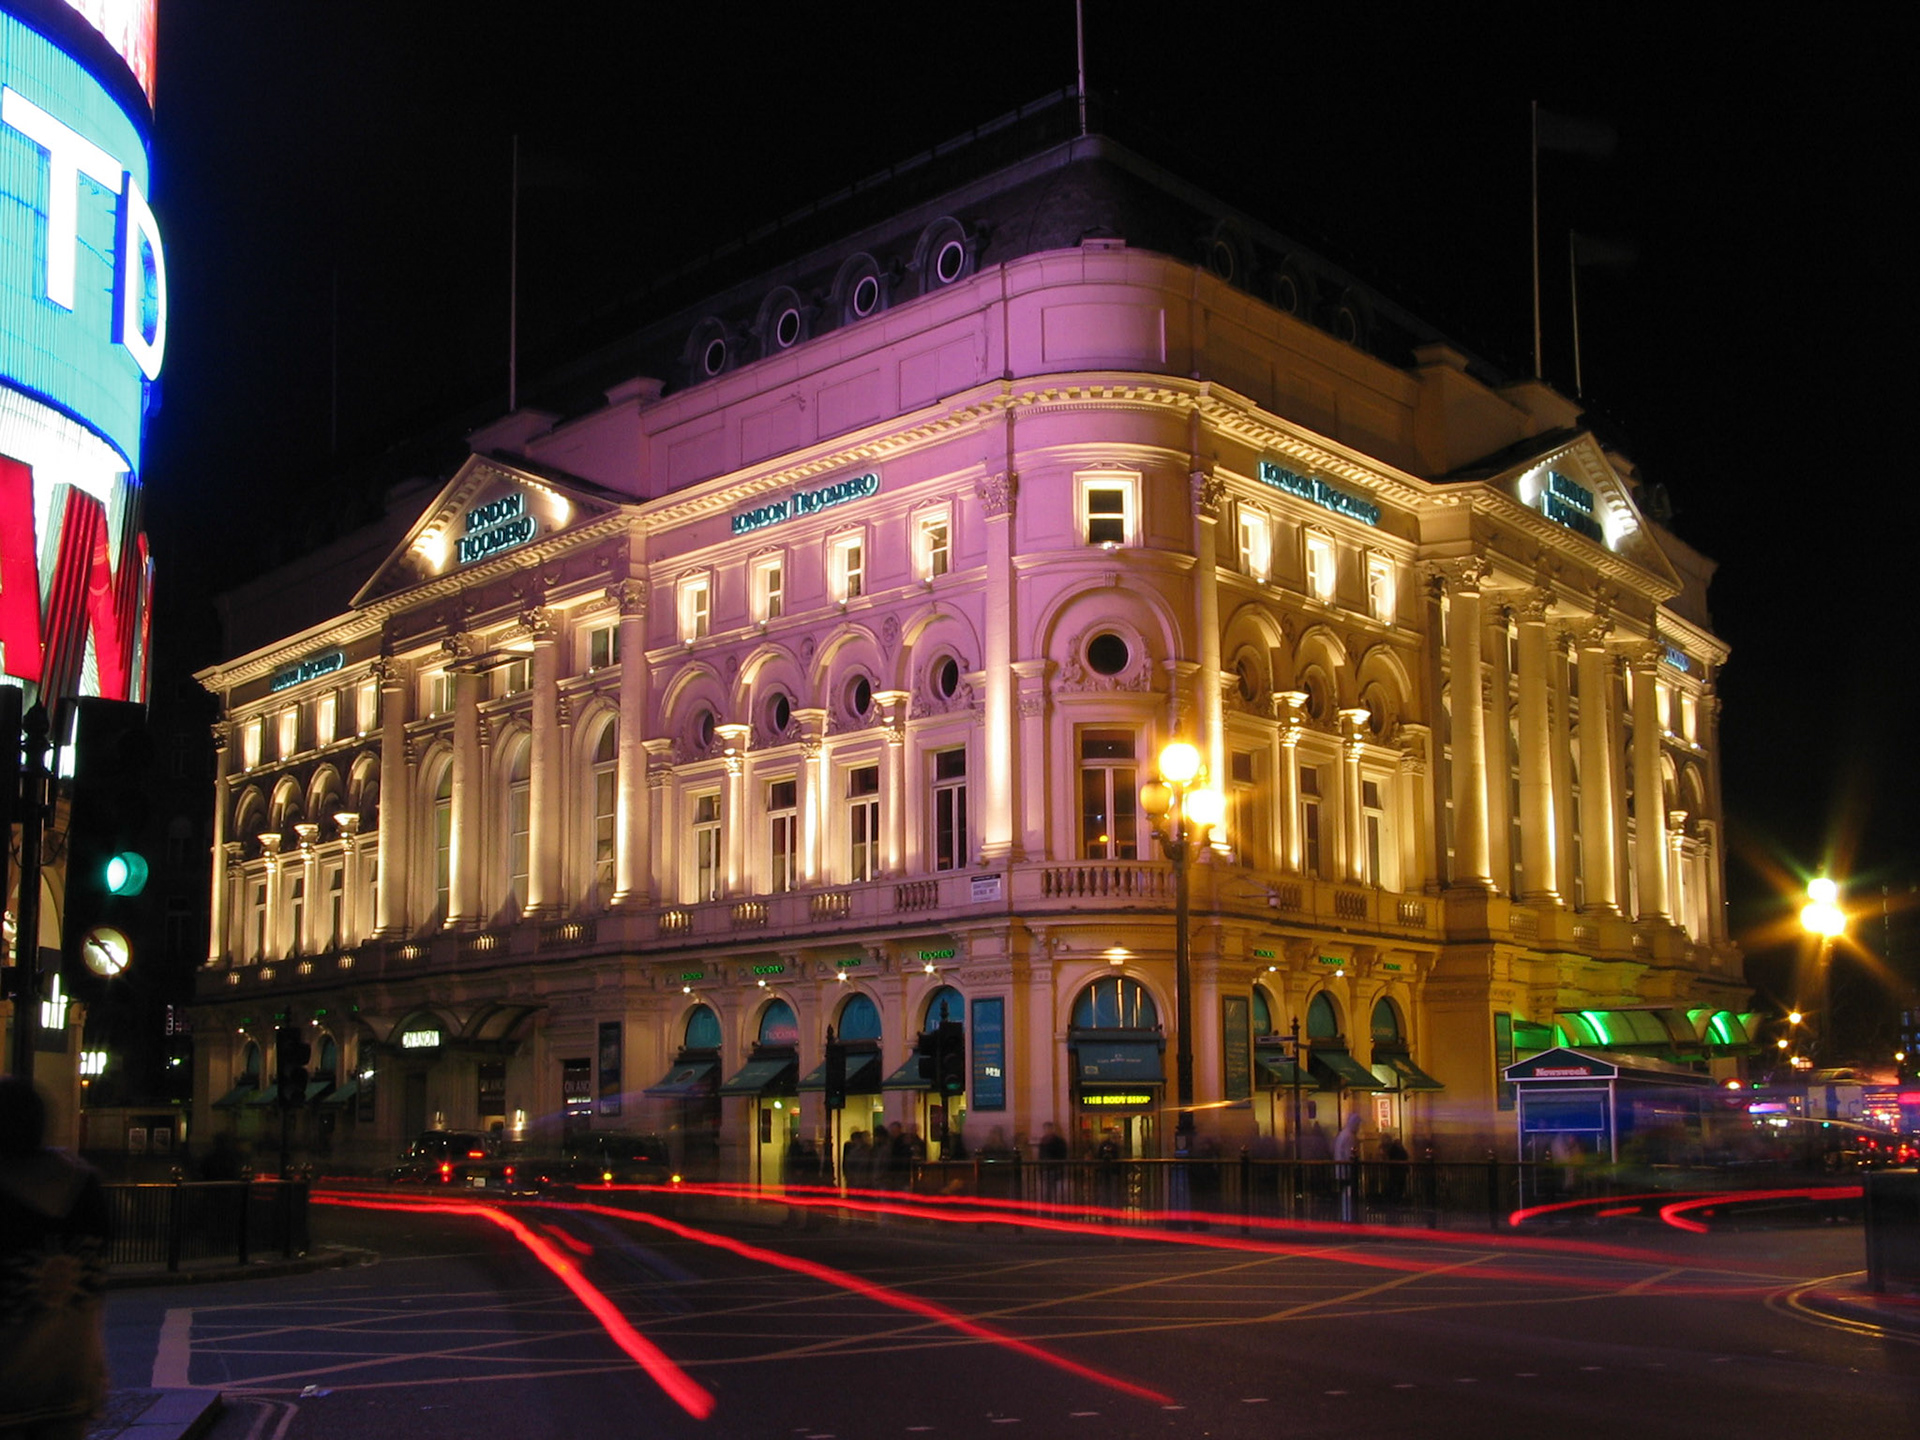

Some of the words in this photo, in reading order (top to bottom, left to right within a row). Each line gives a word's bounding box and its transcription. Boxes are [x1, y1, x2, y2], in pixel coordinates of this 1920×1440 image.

[465, 493, 525, 533] LONDON
[731, 500, 792, 535] LONDON
[791, 472, 880, 517] TROCADERO
[454, 516, 537, 564] TROCADERO
[1535, 1067, 1588, 1077] Newsweek
[1082, 1095, 1102, 1105] THE
[1102, 1095, 1126, 1105] BODY
[1126, 1095, 1151, 1104] SHOP
